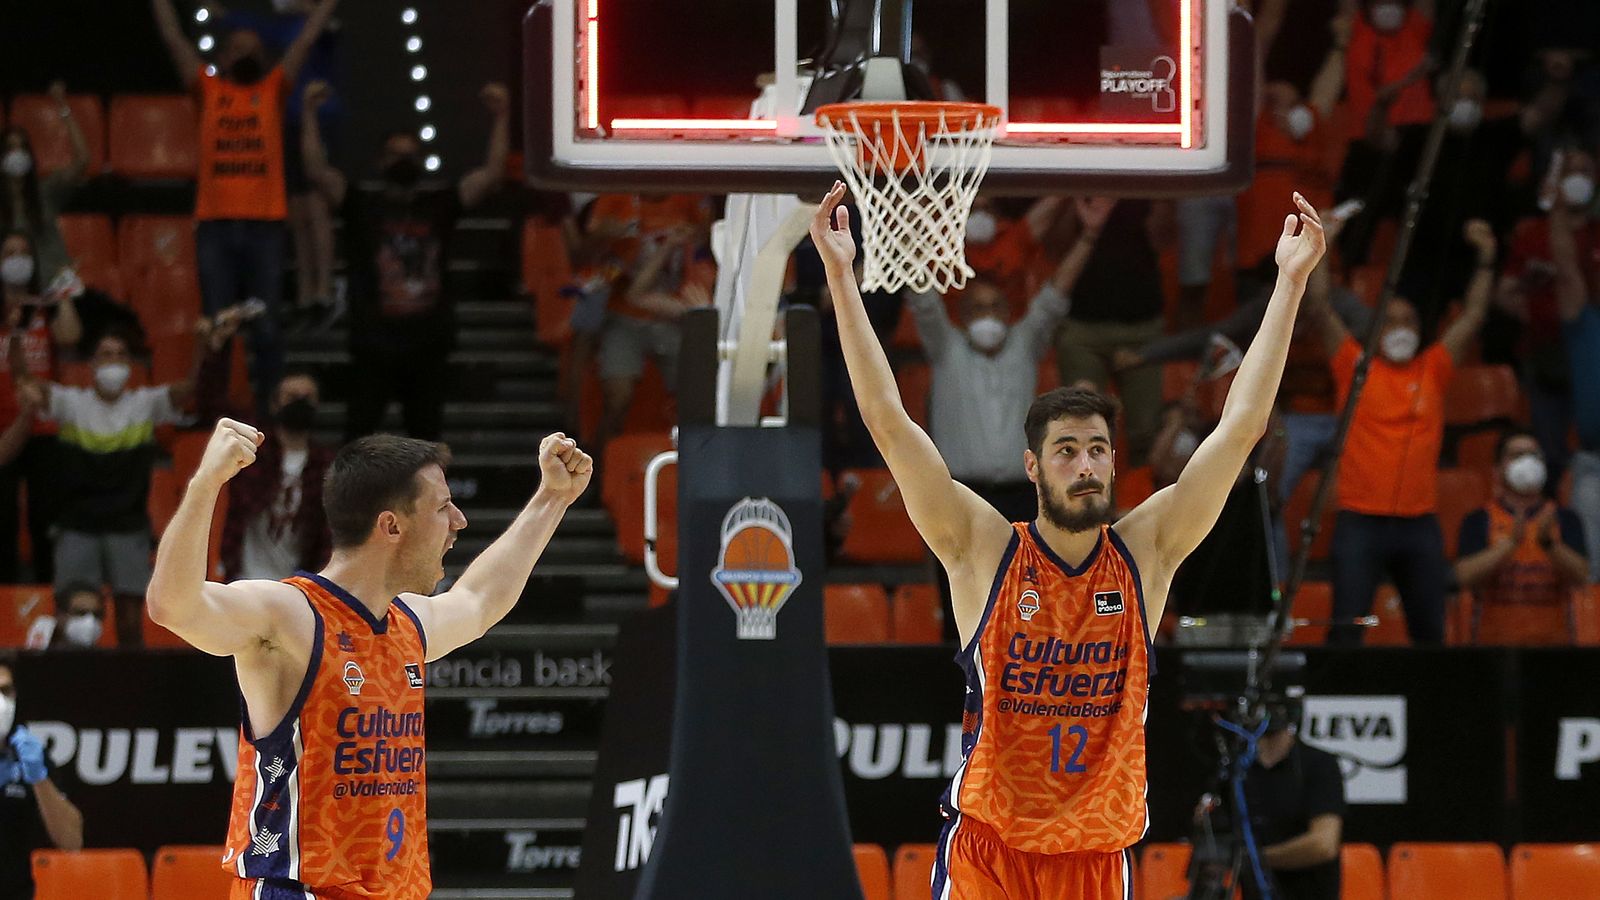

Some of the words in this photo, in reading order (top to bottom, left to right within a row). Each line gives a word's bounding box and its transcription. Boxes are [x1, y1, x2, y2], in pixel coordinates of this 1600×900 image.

[1101, 79, 1167, 93] PLAYOFF
[1008, 631, 1112, 665] Cultura
[1000, 662, 1128, 698] Esfuerzo
[467, 698, 564, 735] Torres
[1047, 723, 1089, 773] 12
[386, 808, 405, 862] 9
